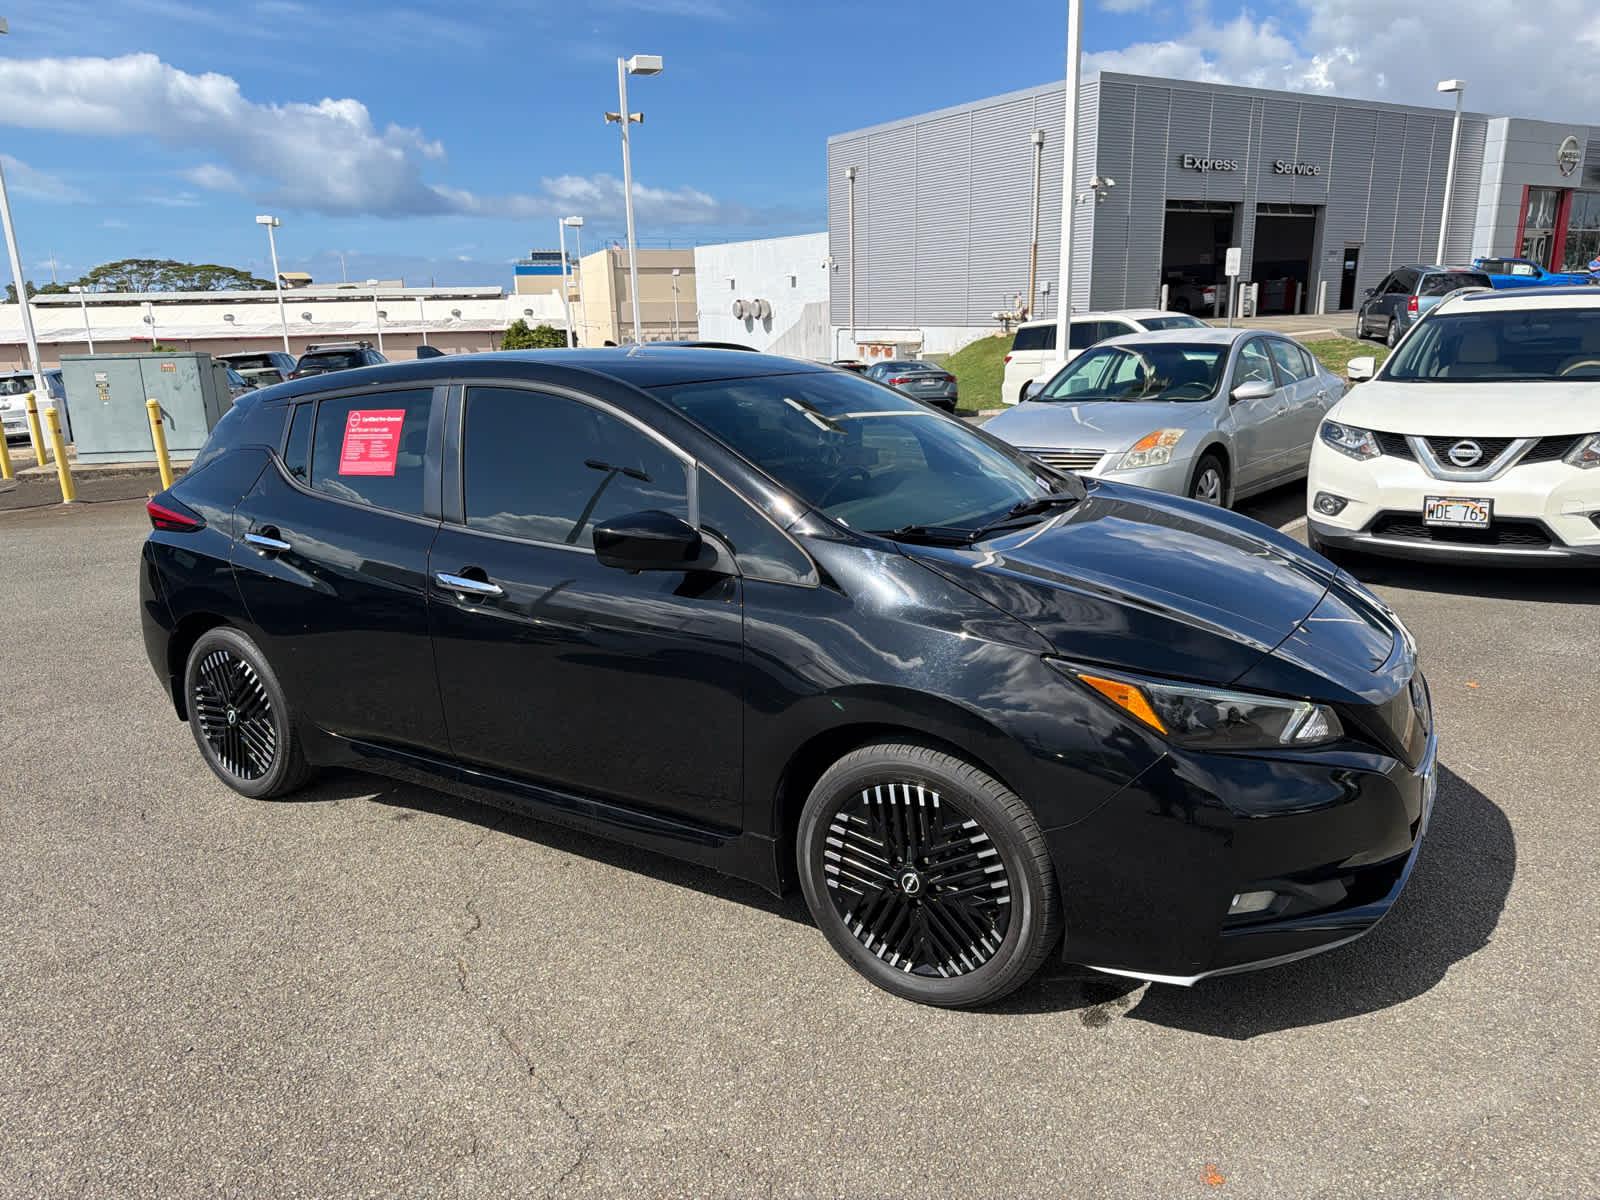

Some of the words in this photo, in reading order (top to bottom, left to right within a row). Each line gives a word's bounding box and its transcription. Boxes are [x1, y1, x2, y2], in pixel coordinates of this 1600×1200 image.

[1183, 154, 1239, 172] Express
[1275, 160, 1321, 176] Service
[1463, 505, 1488, 521] 765
